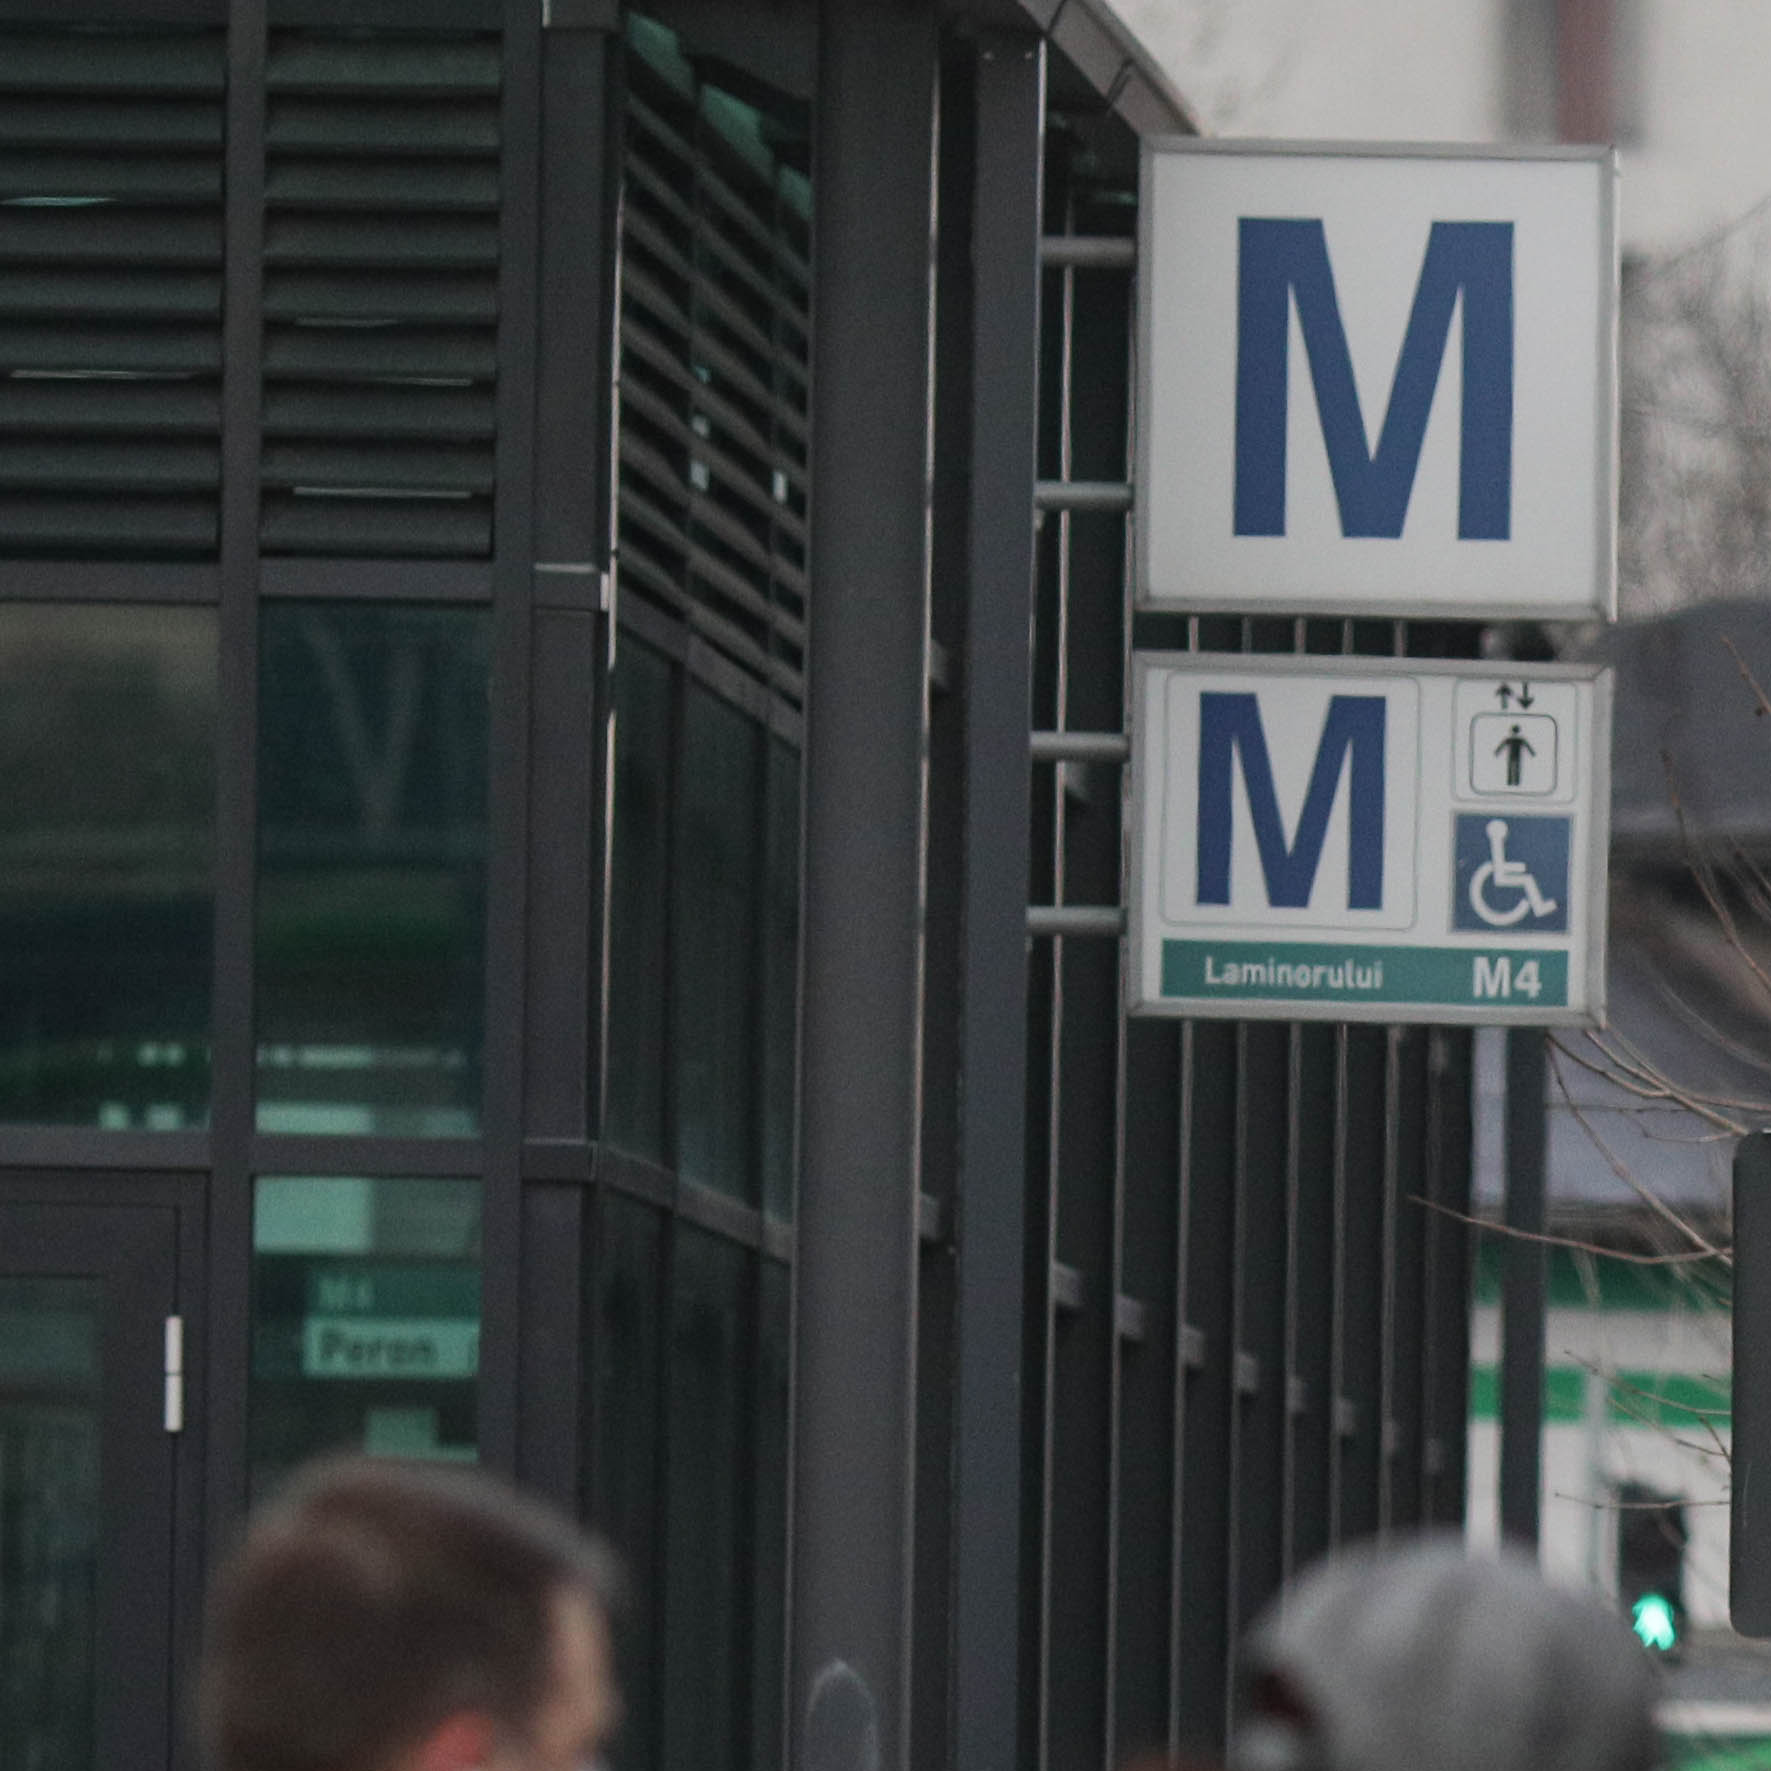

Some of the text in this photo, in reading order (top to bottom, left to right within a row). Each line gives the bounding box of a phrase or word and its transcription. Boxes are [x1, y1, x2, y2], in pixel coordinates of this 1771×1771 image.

[1234, 216, 1514, 541] M
[1195, 691, 1386, 911] M
[1204, 956, 1543, 998] Laminorului M4
